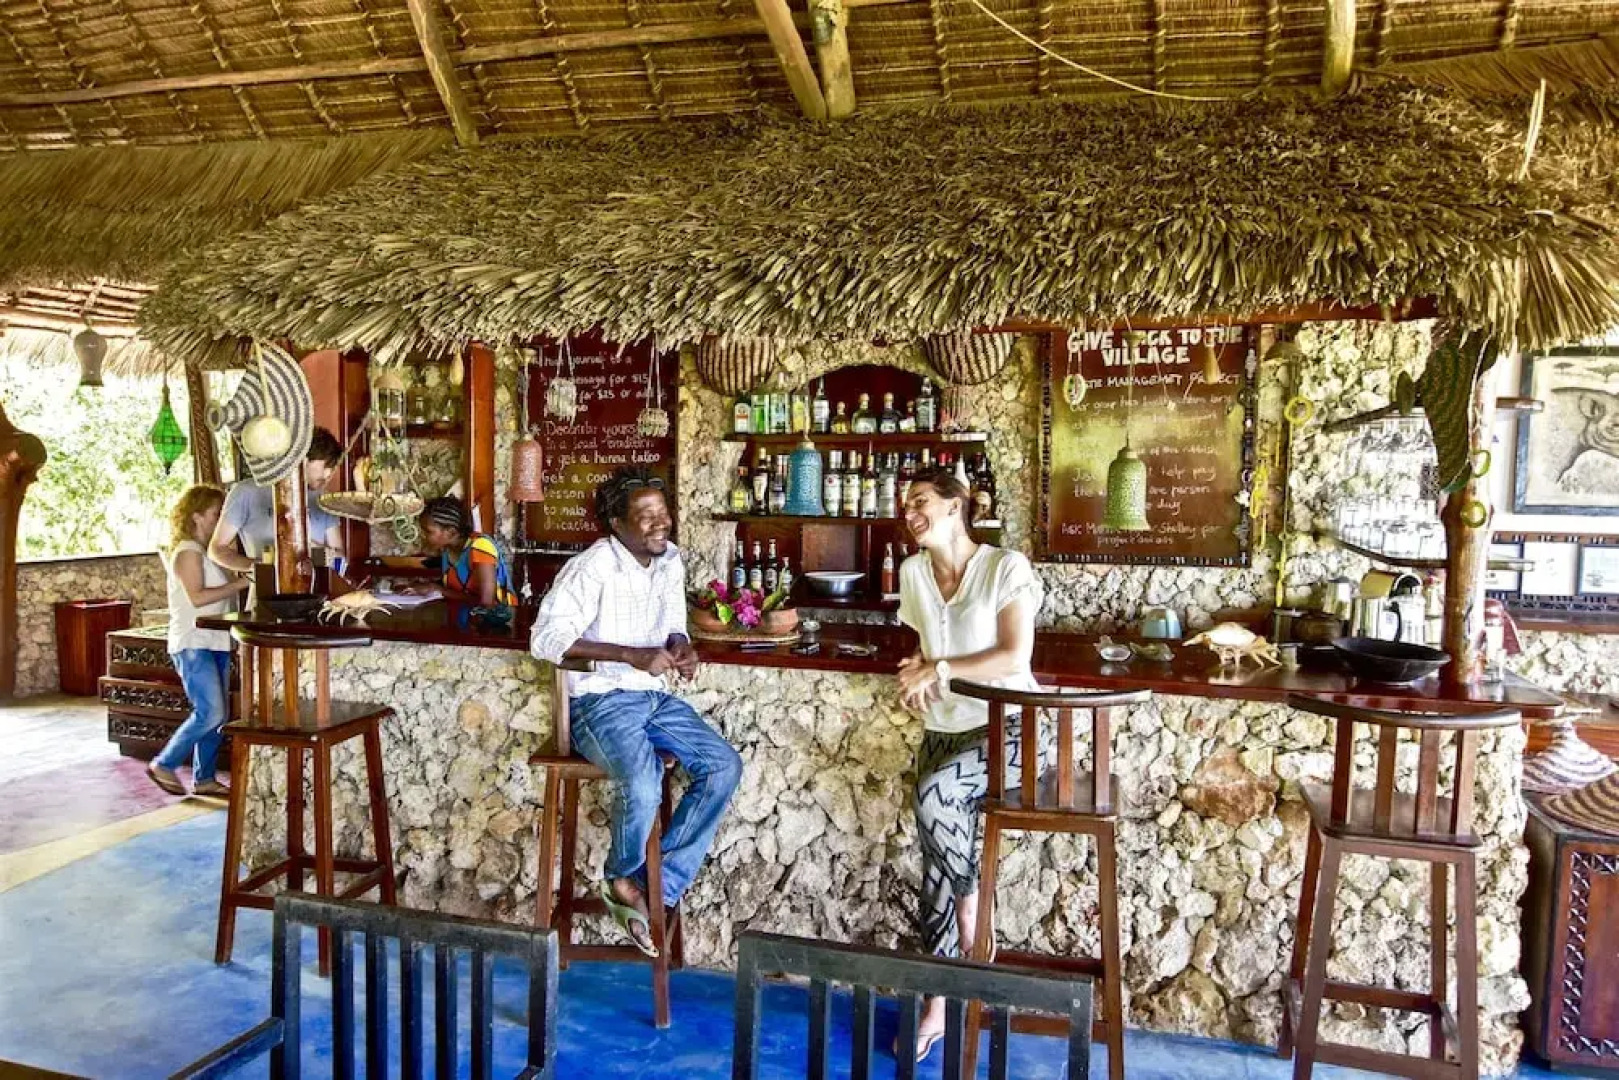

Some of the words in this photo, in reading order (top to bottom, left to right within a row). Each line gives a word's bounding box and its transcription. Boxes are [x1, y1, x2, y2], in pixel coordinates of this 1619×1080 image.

[1067, 331, 1114, 351] GIVE
[1177, 329, 1200, 345] TO
[1101, 347, 1190, 366] VILLAGE
